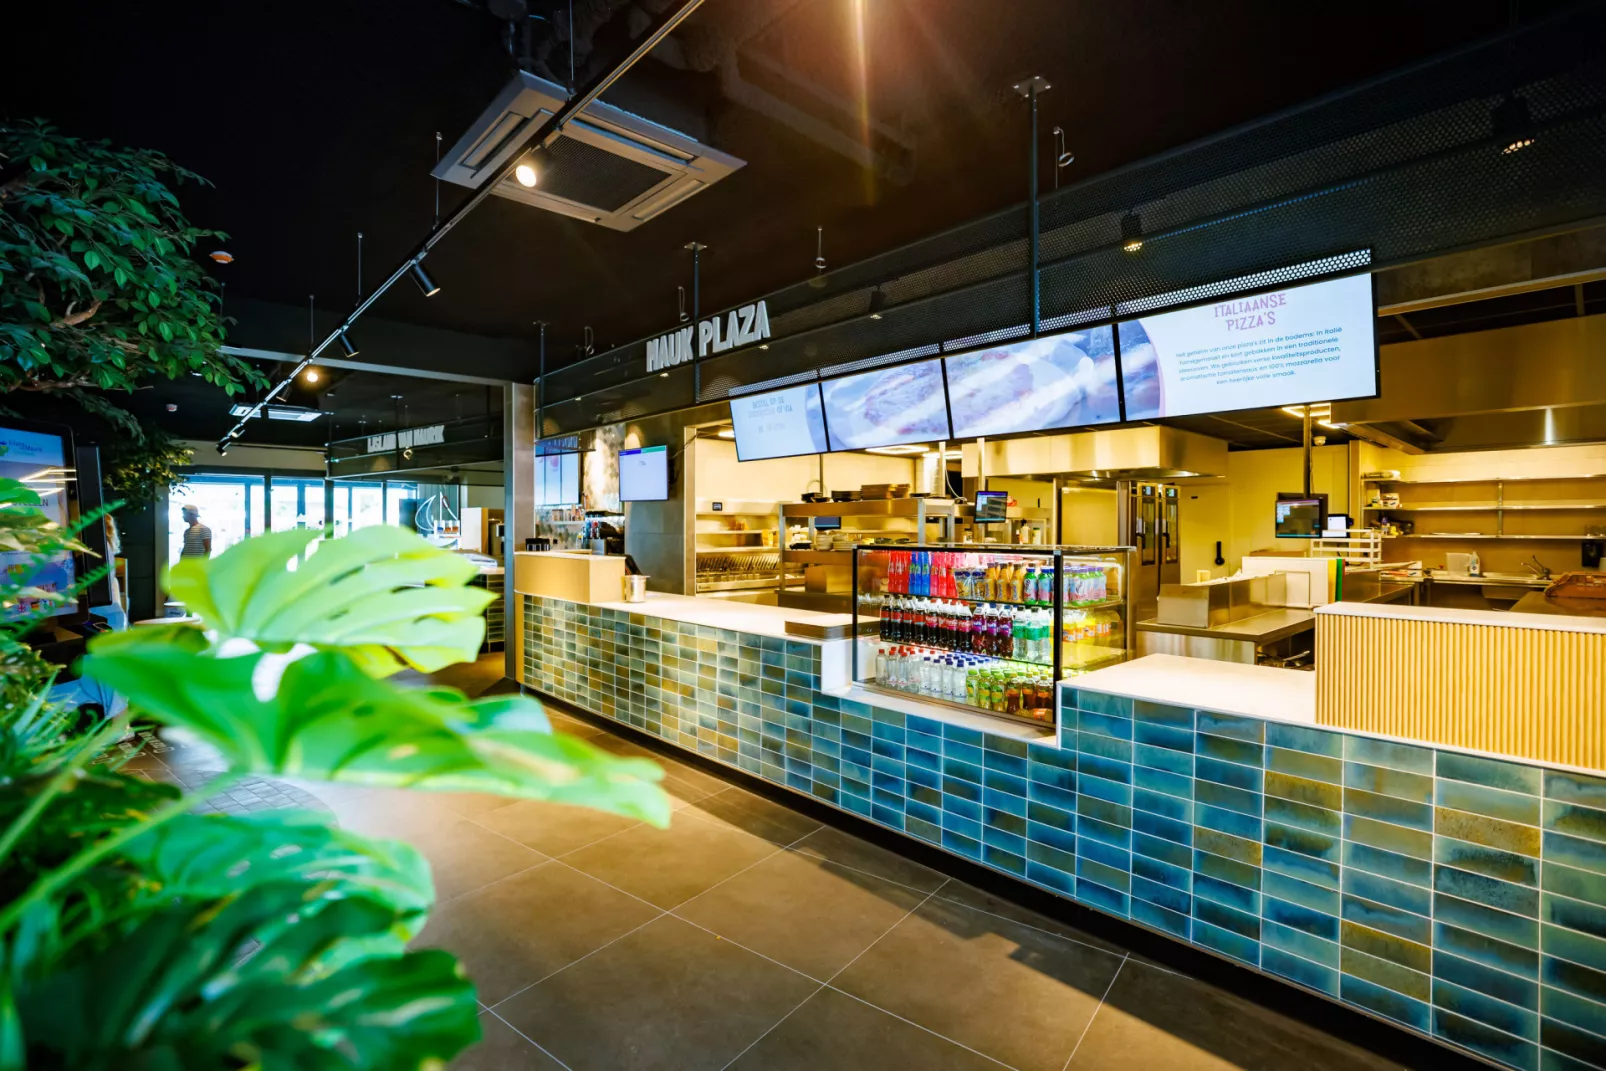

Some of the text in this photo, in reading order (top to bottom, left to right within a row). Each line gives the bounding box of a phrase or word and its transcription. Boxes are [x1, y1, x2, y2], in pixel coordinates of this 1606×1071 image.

[1214, 293, 1287, 318] ITALIAANSE
[698, 300, 771, 357] PLAZA
[1225, 311, 1276, 331] PIZZA'S
[1298, 337, 1338, 348] traditionele
[1286, 358, 1323, 367] mozzarella
